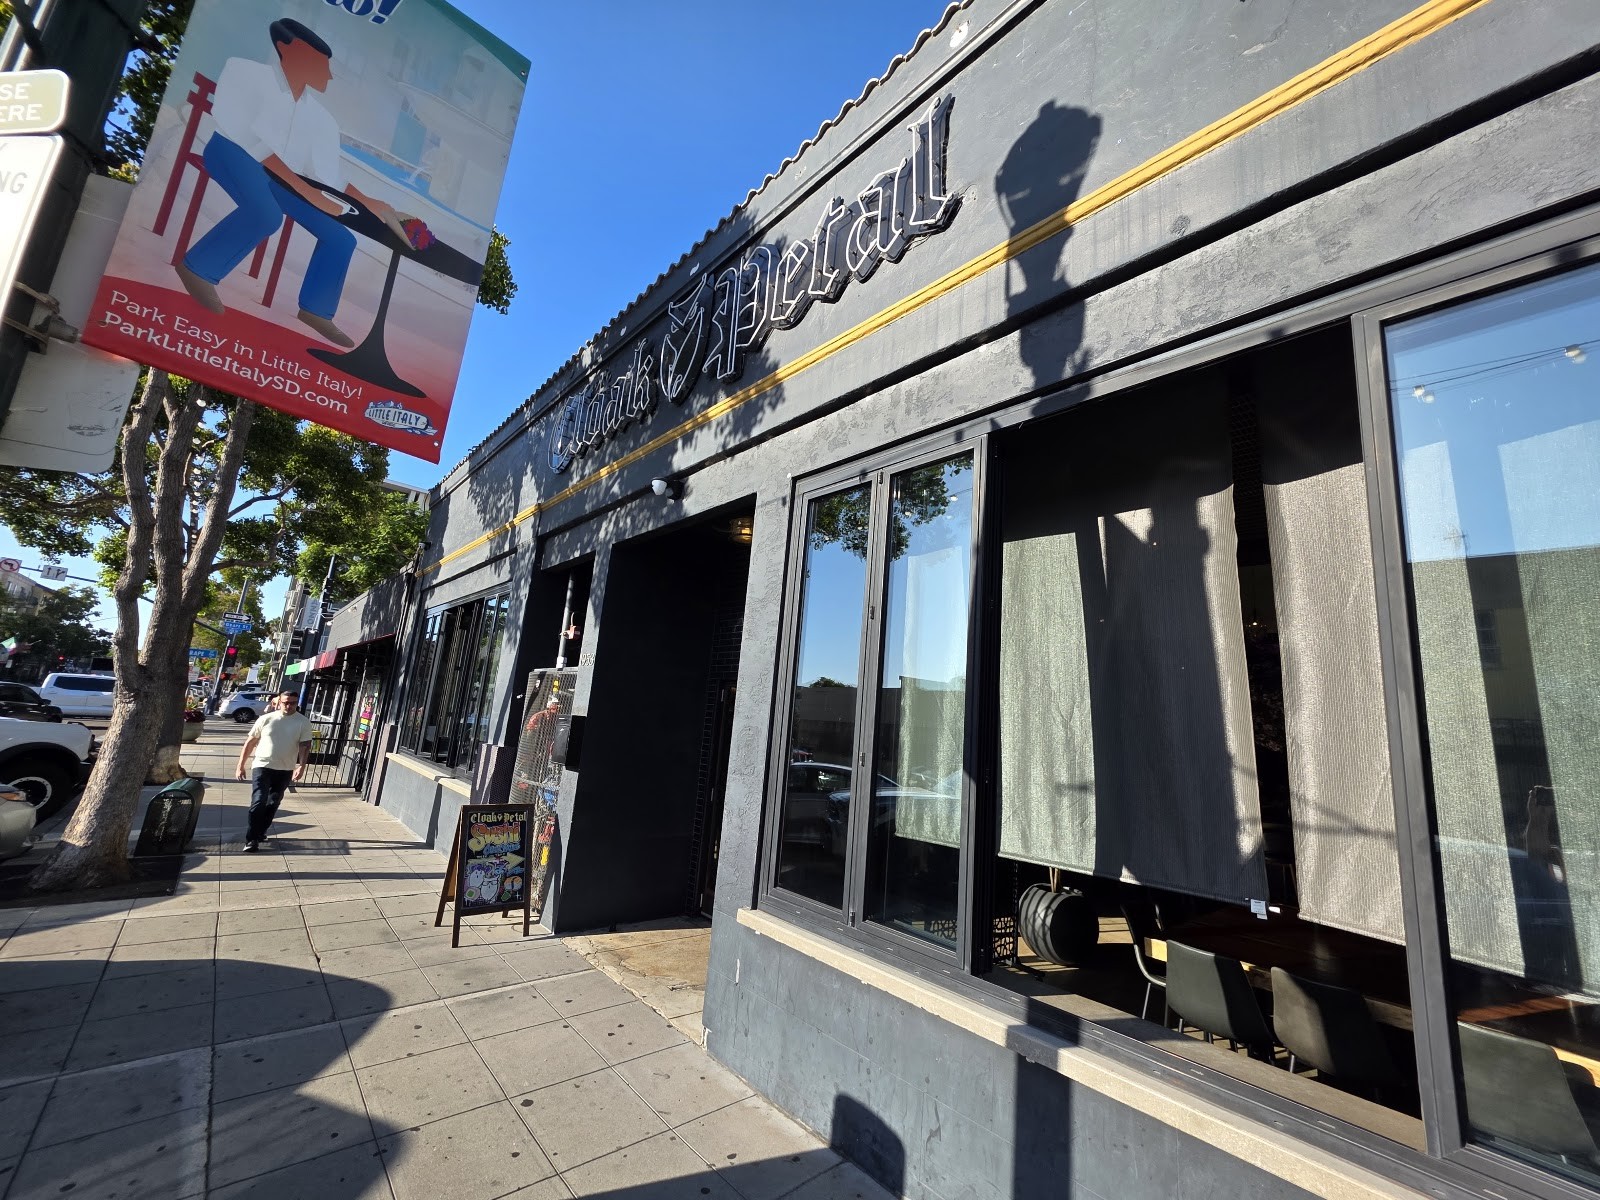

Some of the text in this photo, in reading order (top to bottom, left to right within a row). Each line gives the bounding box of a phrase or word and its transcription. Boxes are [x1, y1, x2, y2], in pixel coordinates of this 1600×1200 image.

[702, 94, 962, 382] Petal
[104, 311, 348, 414] ParkLittleItalySD.com
[110, 290, 363, 400] Park Easy in Little Italy!
[368, 408, 390, 420] LITTLE
[392, 410, 421, 427] ITALY
[468, 822, 521, 852] Sushi
[470, 812, 497, 823] Cloak
